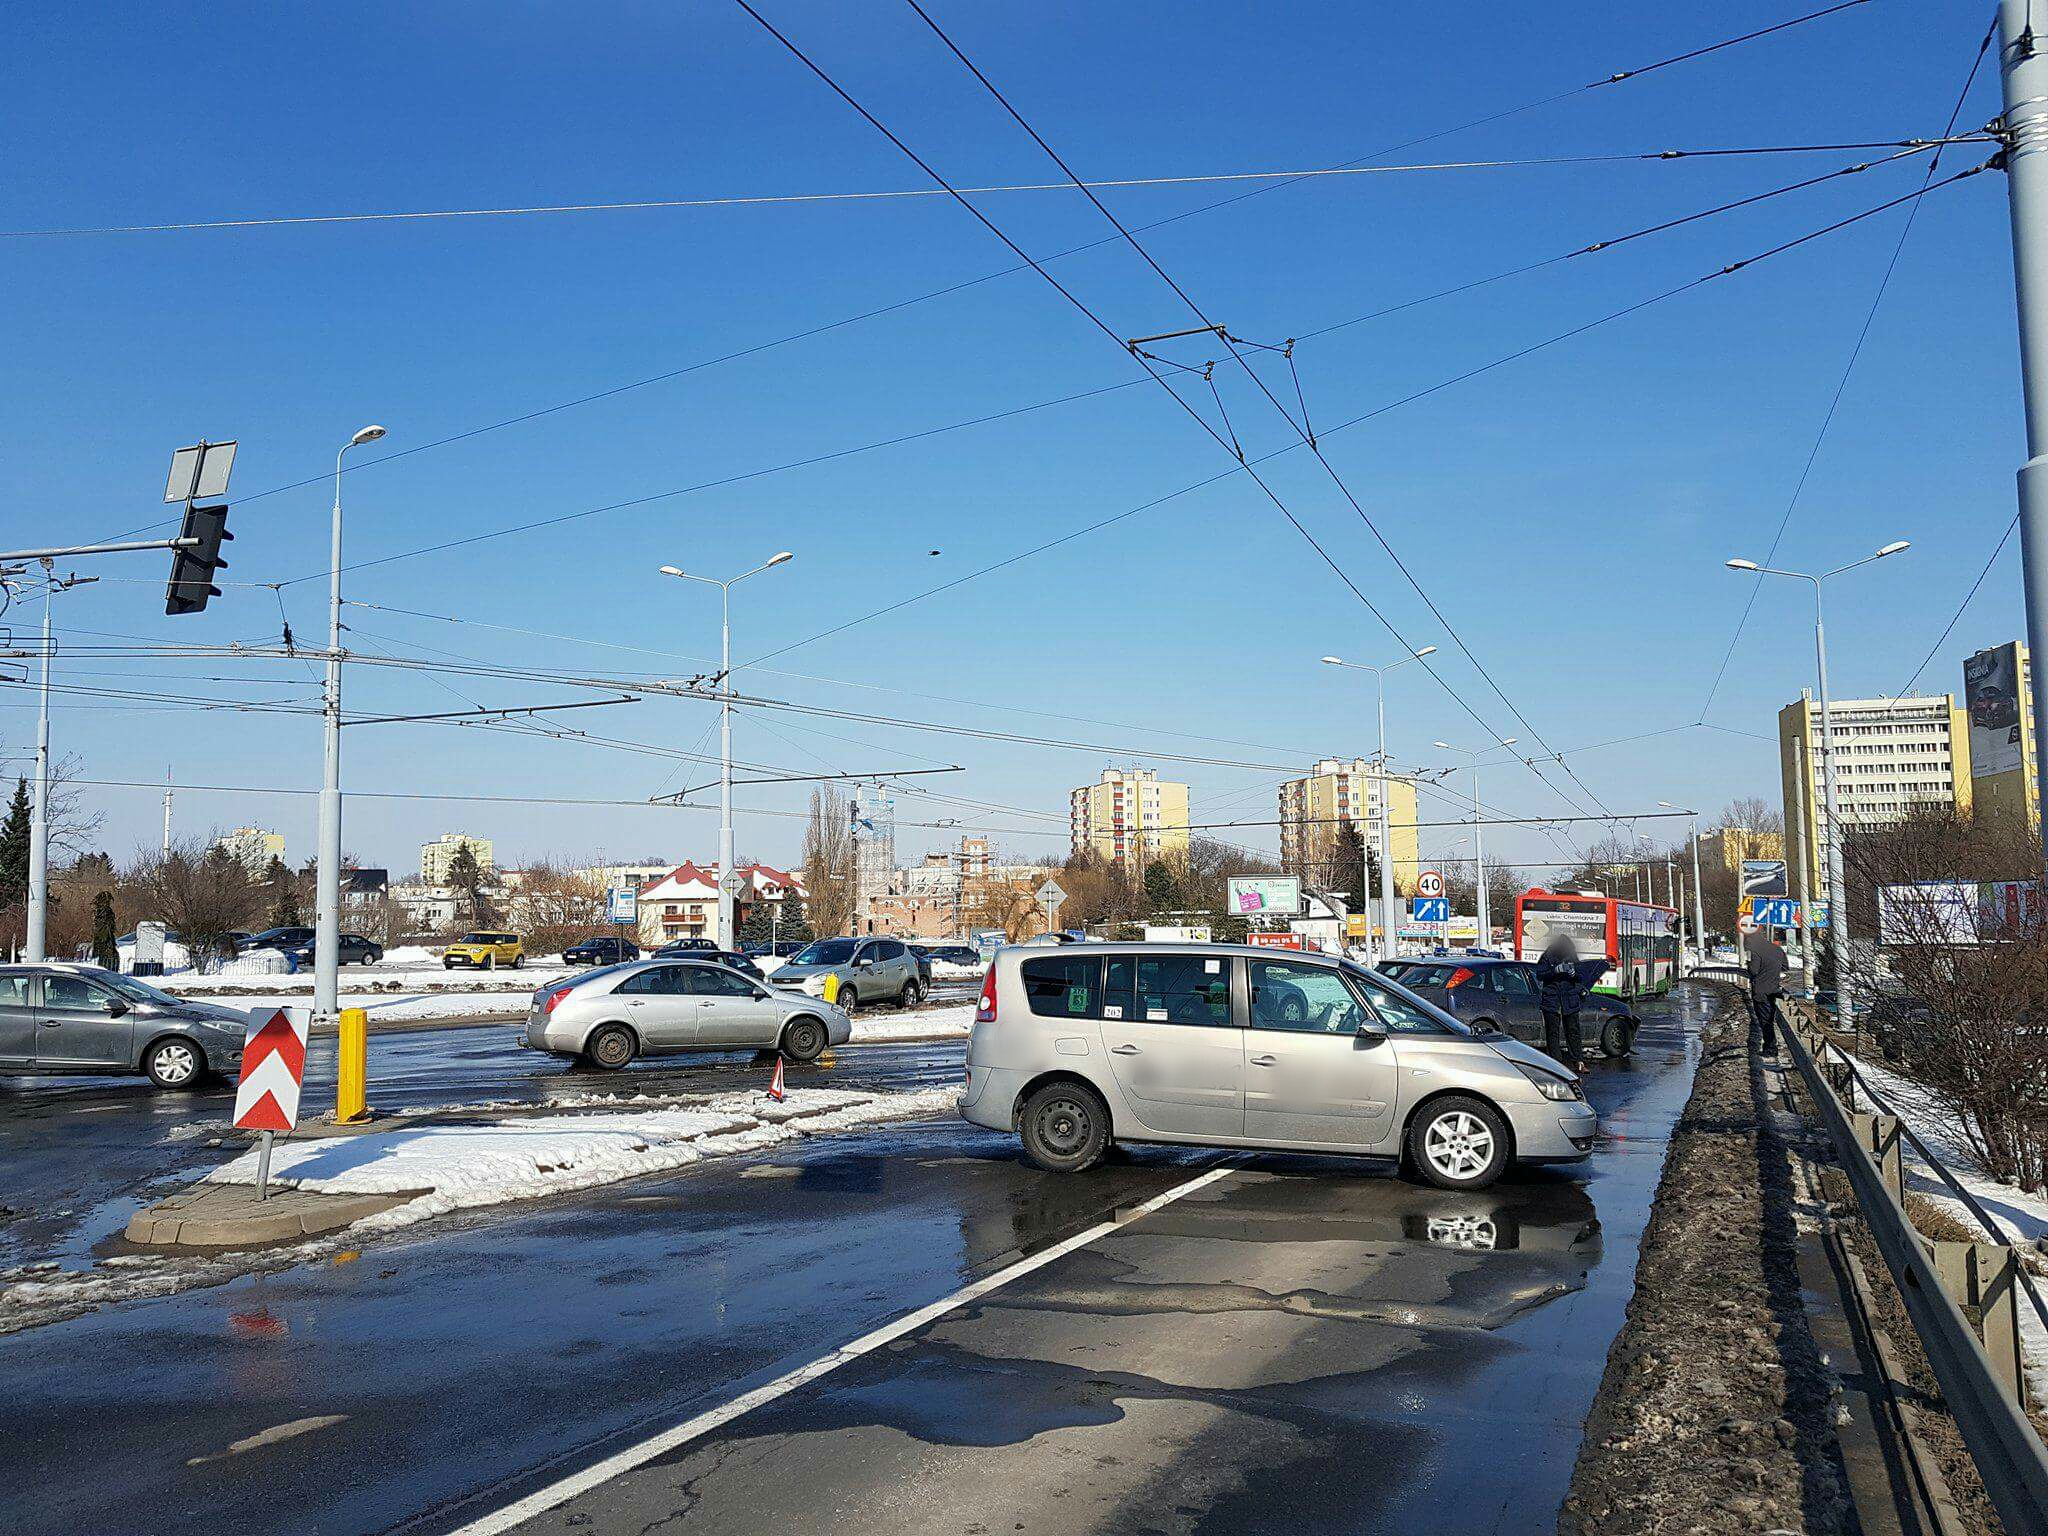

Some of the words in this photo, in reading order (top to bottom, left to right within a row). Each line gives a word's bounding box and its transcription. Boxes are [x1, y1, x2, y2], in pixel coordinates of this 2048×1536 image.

[1421, 878, 1440, 891] 40
[1524, 953, 1538, 961] 2312
[1106, 1008, 1120, 1016] 202
